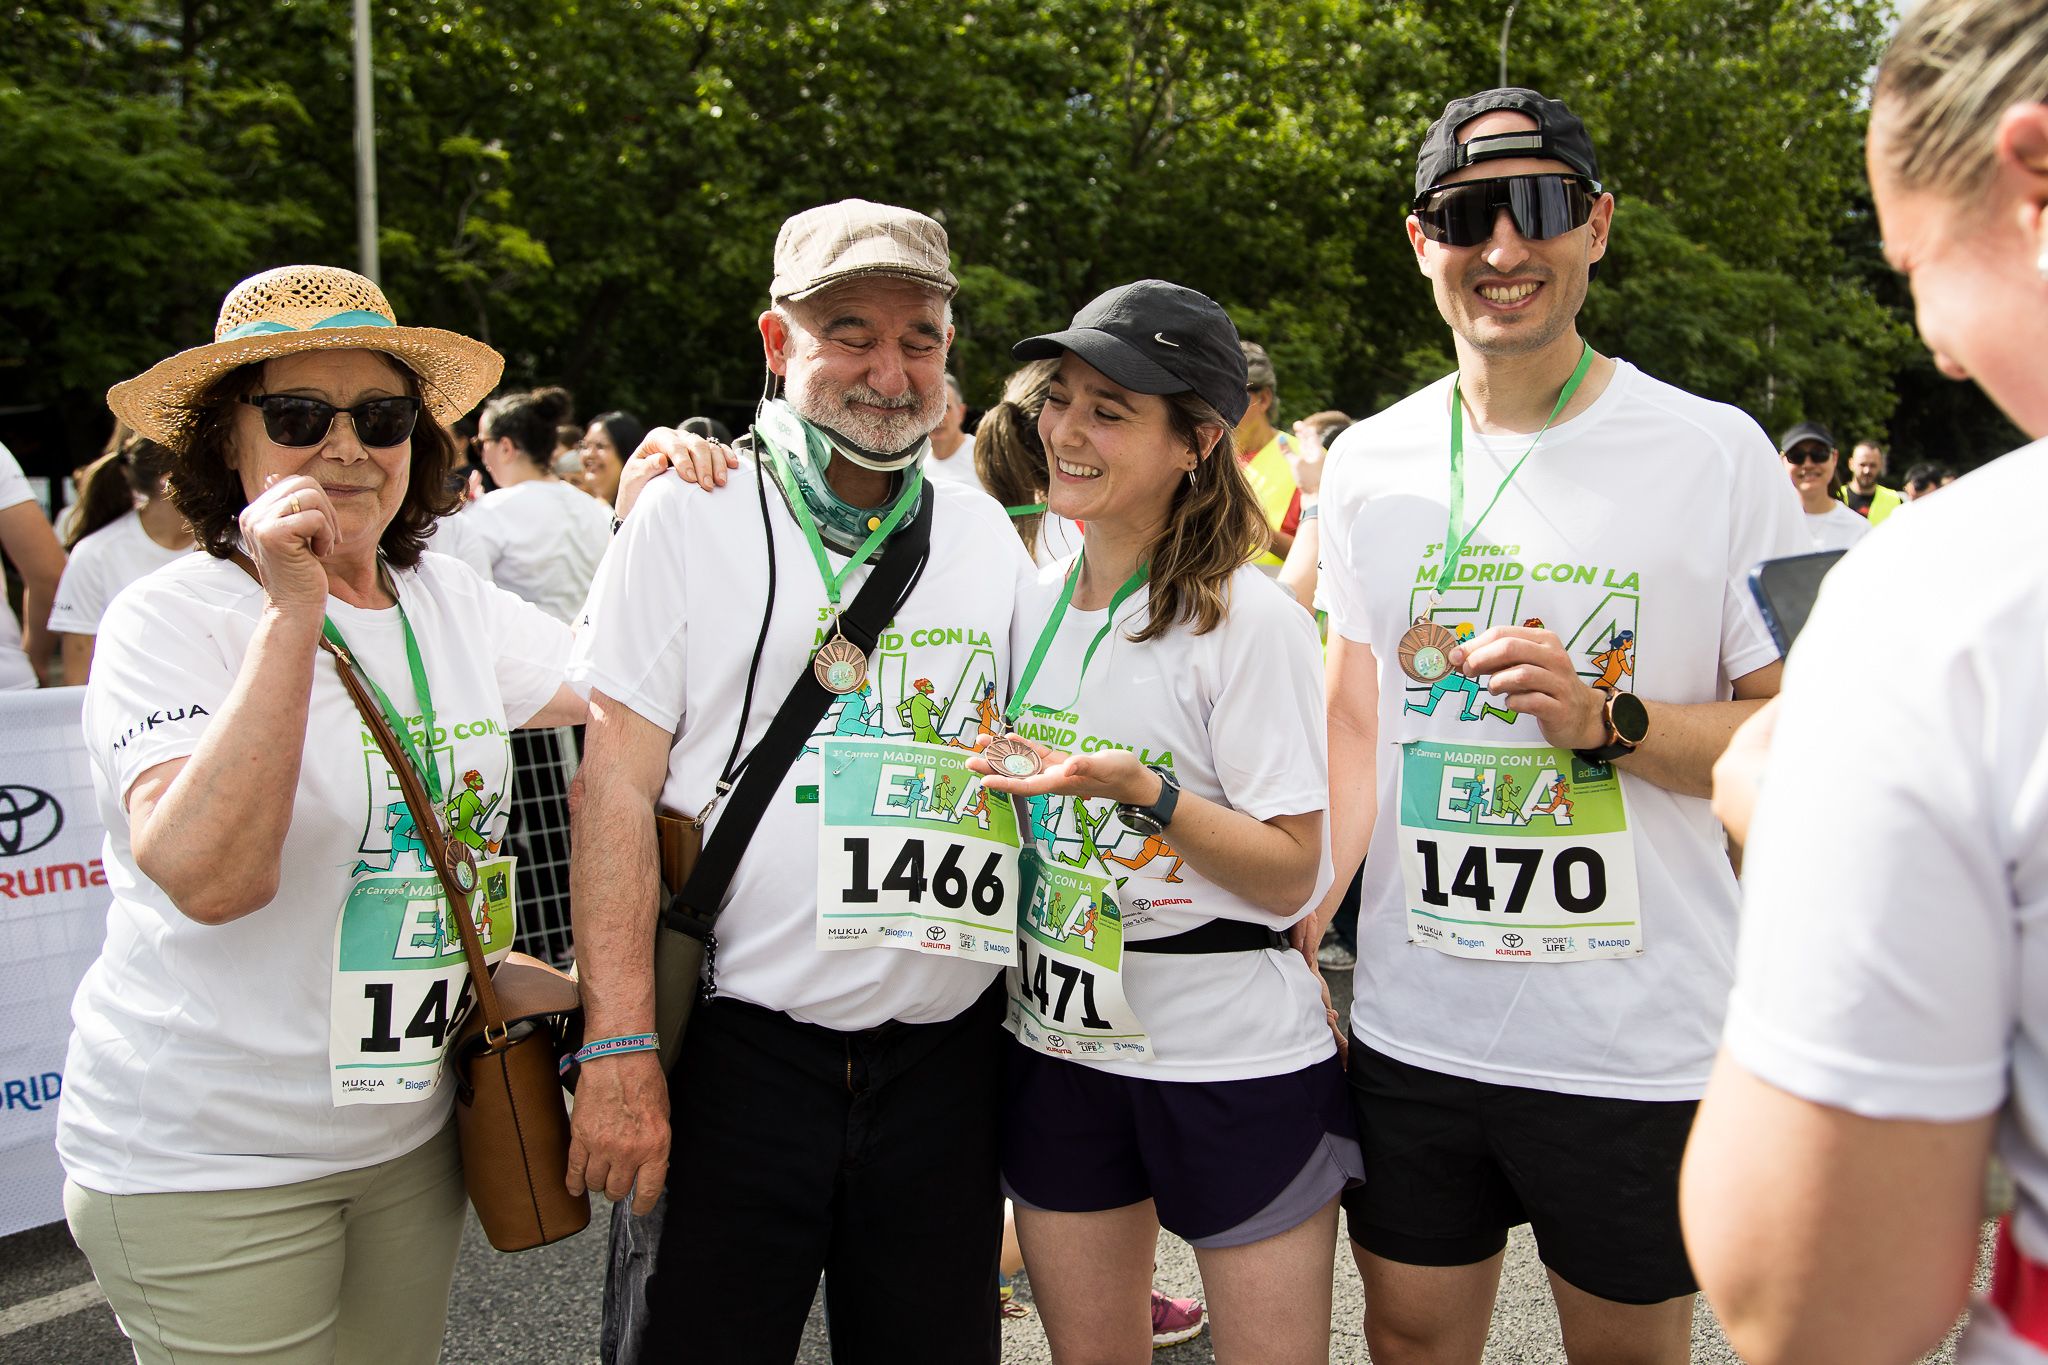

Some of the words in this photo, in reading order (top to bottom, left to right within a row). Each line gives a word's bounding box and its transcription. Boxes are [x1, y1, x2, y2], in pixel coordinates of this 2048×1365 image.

[1460, 543, 1521, 557] arrera
[1416, 563, 1524, 583] MDRID
[1531, 563, 1598, 585] CON
[1602, 568, 1640, 592] LA
[911, 628, 962, 648] CON
[968, 628, 992, 648] LA
[1017, 722, 1077, 747] MADRID
[1139, 748, 1174, 767] LA
[844, 750, 879, 759] Carrera
[883, 751, 936, 765] MADRID
[1417, 748, 1441, 758] Carrera
[1444, 752, 1496, 766] MADRID
[1501, 755, 1533, 767] CON
[1537, 755, 1556, 766] LA
[871, 764, 989, 830] ELA
[1436, 765, 1573, 826] ELA
[842, 838, 1004, 916] 1466
[1417, 838, 1607, 914] 1470
[1055, 875, 1077, 889] CON
[1079, 881, 1092, 893] LA
[1026, 875, 1094, 951] ELA
[884, 928, 913, 938] Biogen
[1417, 923, 1443, 937] MUKUA
[961, 940, 971, 949] LIFE
[989, 943, 1010, 955] MADRID
[1457, 936, 1484, 948] Biogen
[1546, 944, 1566, 952] LIFE
[1597, 939, 1631, 948] MADRID
[1020, 938, 1113, 1030] 1471
[595, 1041, 612, 1051] por
[615, 1038, 645, 1048] Ruega
[1121, 1043, 1145, 1053] MADRID
[0, 1072, 63, 1110] RID
[405, 1080, 431, 1090] Biogen
